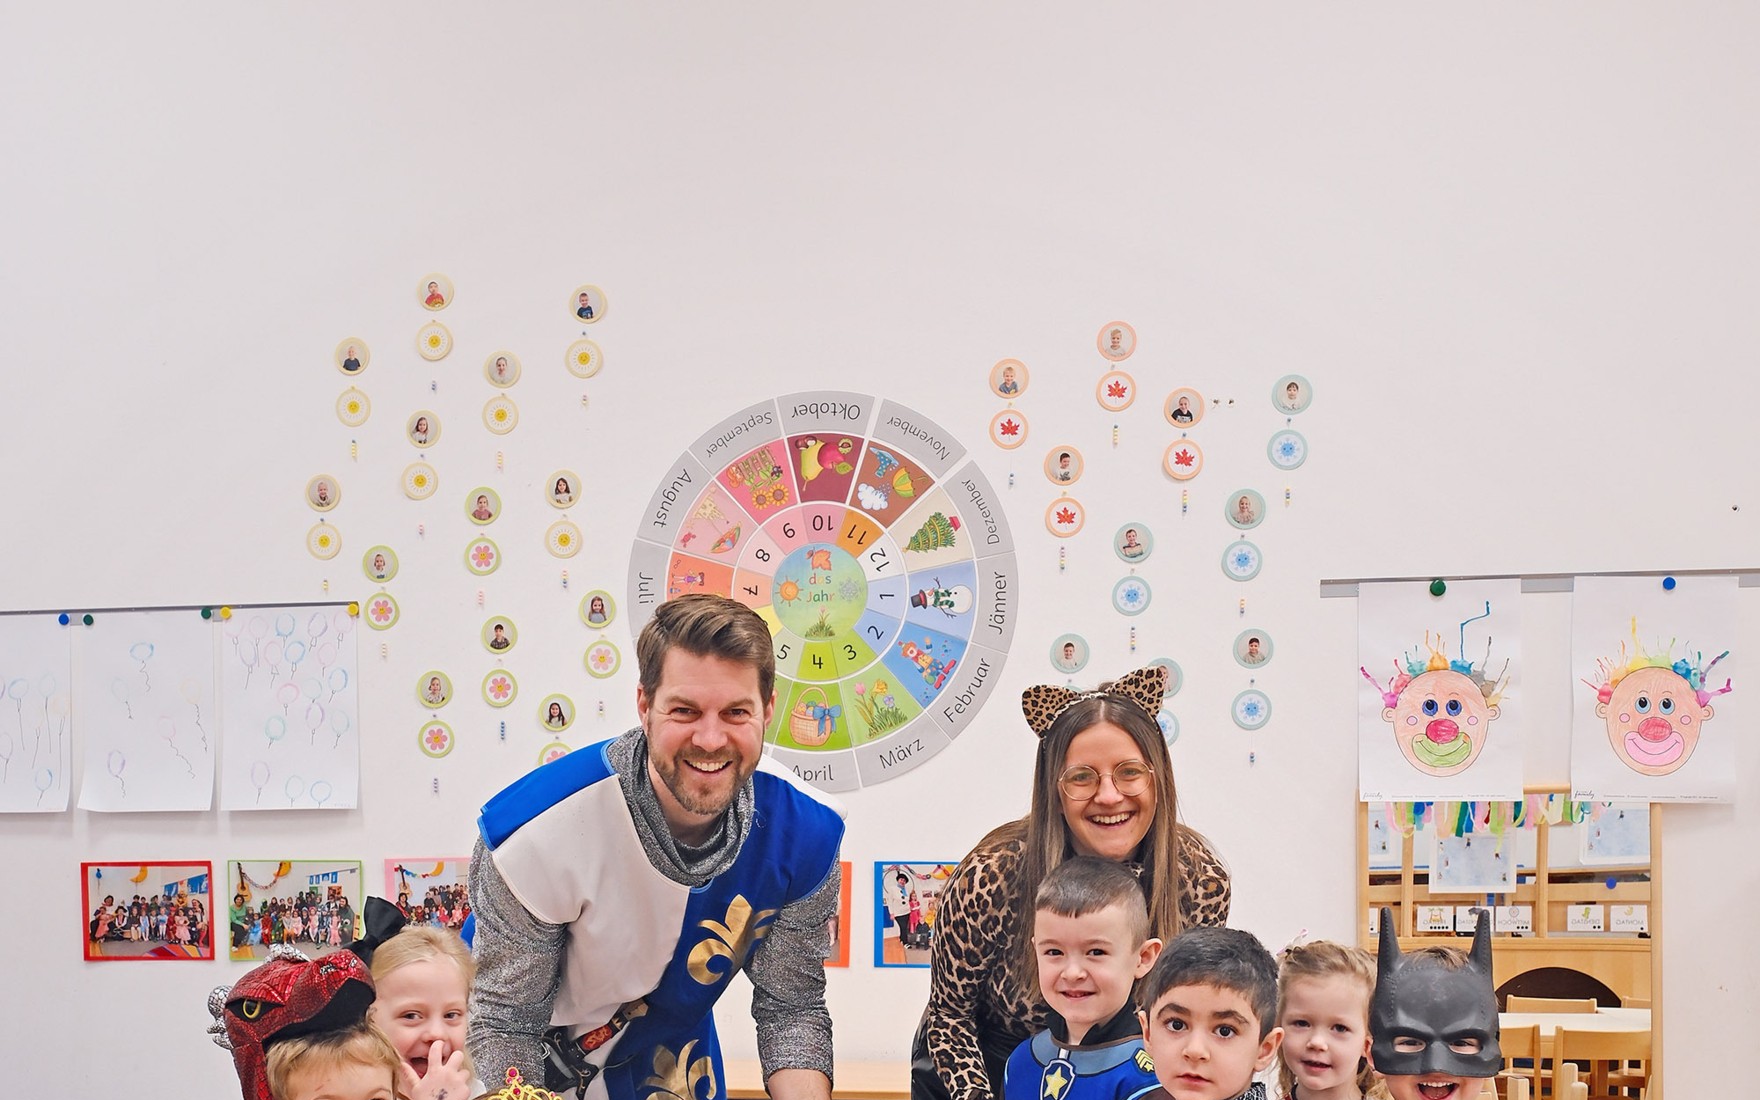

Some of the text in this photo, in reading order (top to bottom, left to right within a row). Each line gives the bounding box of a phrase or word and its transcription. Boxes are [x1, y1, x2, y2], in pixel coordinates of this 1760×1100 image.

[791, 402, 861, 421] Oktober
[705, 411, 773, 459] September
[886, 415, 950, 461] November
[654, 468, 693, 527] August
[963, 478, 1000, 545] Dezember
[782, 522, 796, 539] 9
[812, 515, 834, 531] 10
[847, 524, 867, 545] 11
[755, 548, 771, 562] 8
[870, 547, 890, 572] 12
[637, 572, 654, 604] Juli
[808, 573, 832, 585] das
[743, 585, 758, 596] 7
[806, 590, 835, 603] Jahr
[988, 571, 1007, 635] Jänner
[867, 625, 884, 640] 2
[776, 644, 791, 660] 5
[843, 644, 857, 661] 3
[812, 654, 824, 670] 4
[944, 657, 991, 724] Februar
[879, 738, 925, 770] März
